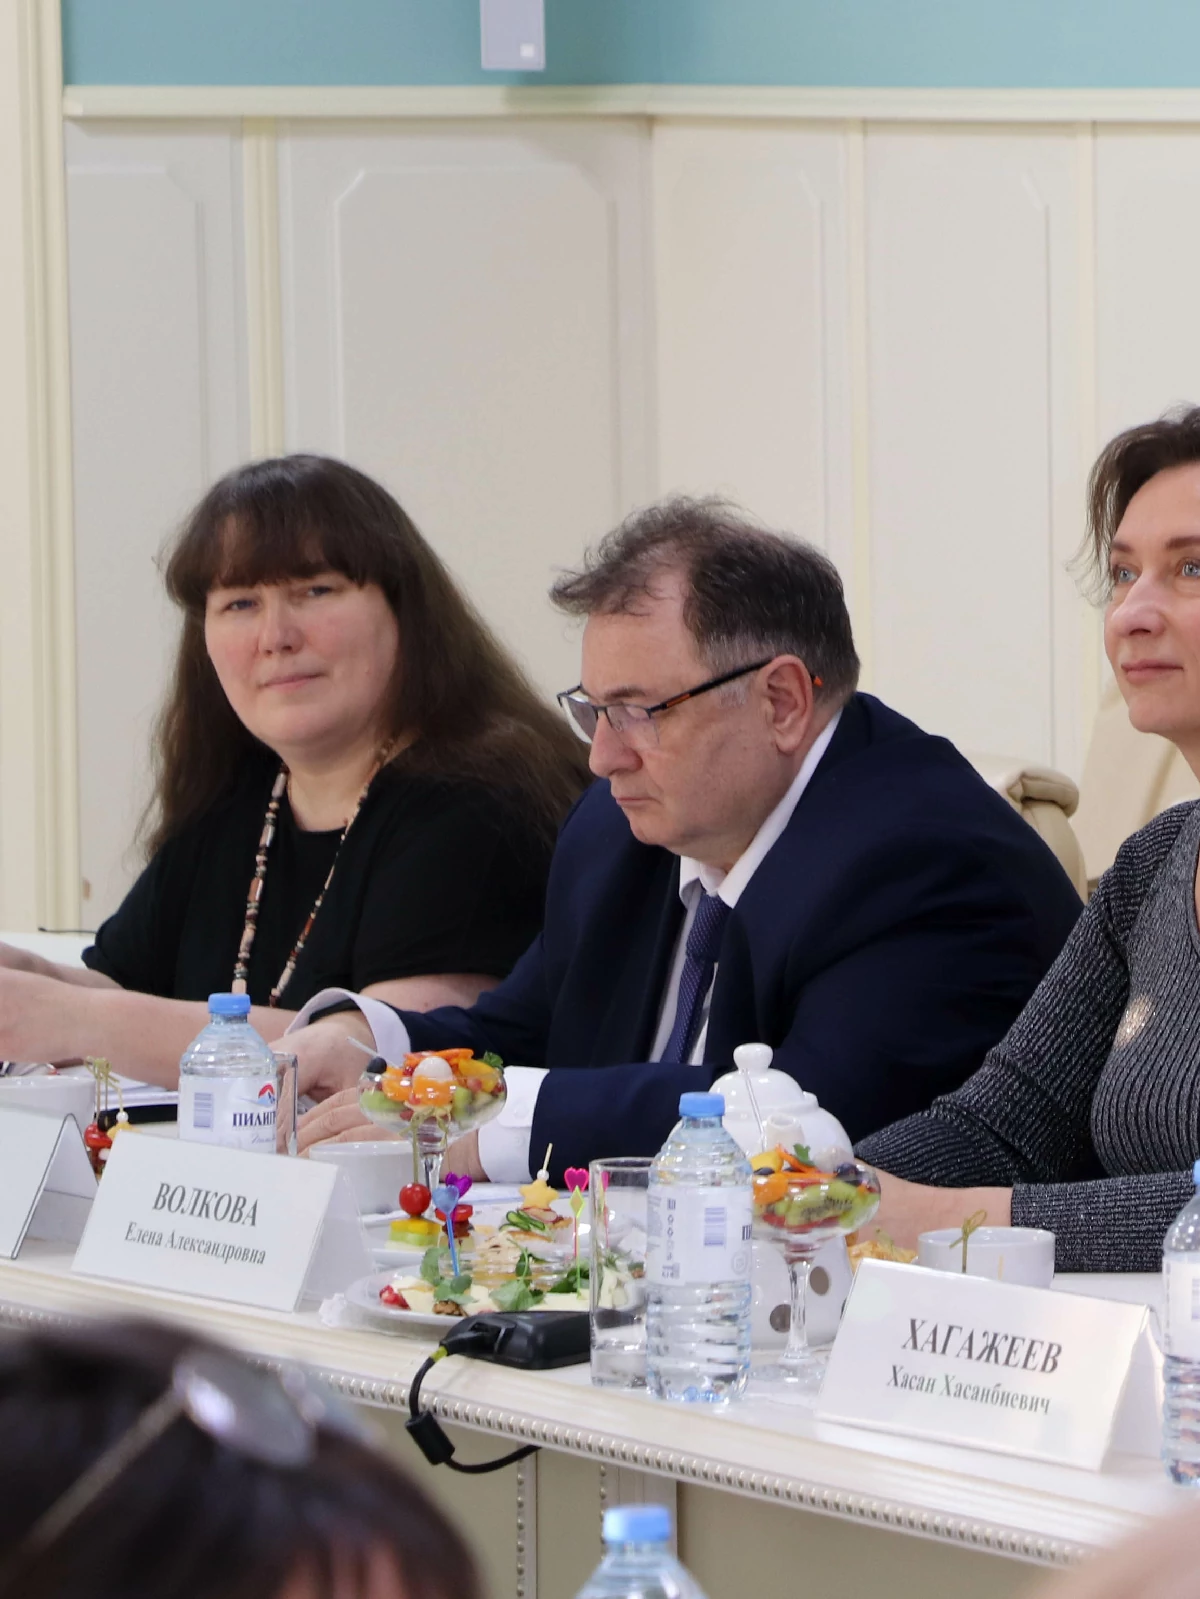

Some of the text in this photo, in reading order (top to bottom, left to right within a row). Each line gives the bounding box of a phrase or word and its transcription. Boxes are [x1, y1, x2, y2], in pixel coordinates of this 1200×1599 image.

[152, 1181, 259, 1227] ВОЛКОВА
[124, 1221, 266, 1264] Елена Александровна
[901, 1318, 1063, 1374] ХАГАЖЕЕВ
[886, 1364, 1051, 1415] Хасан Хасанбиевич
